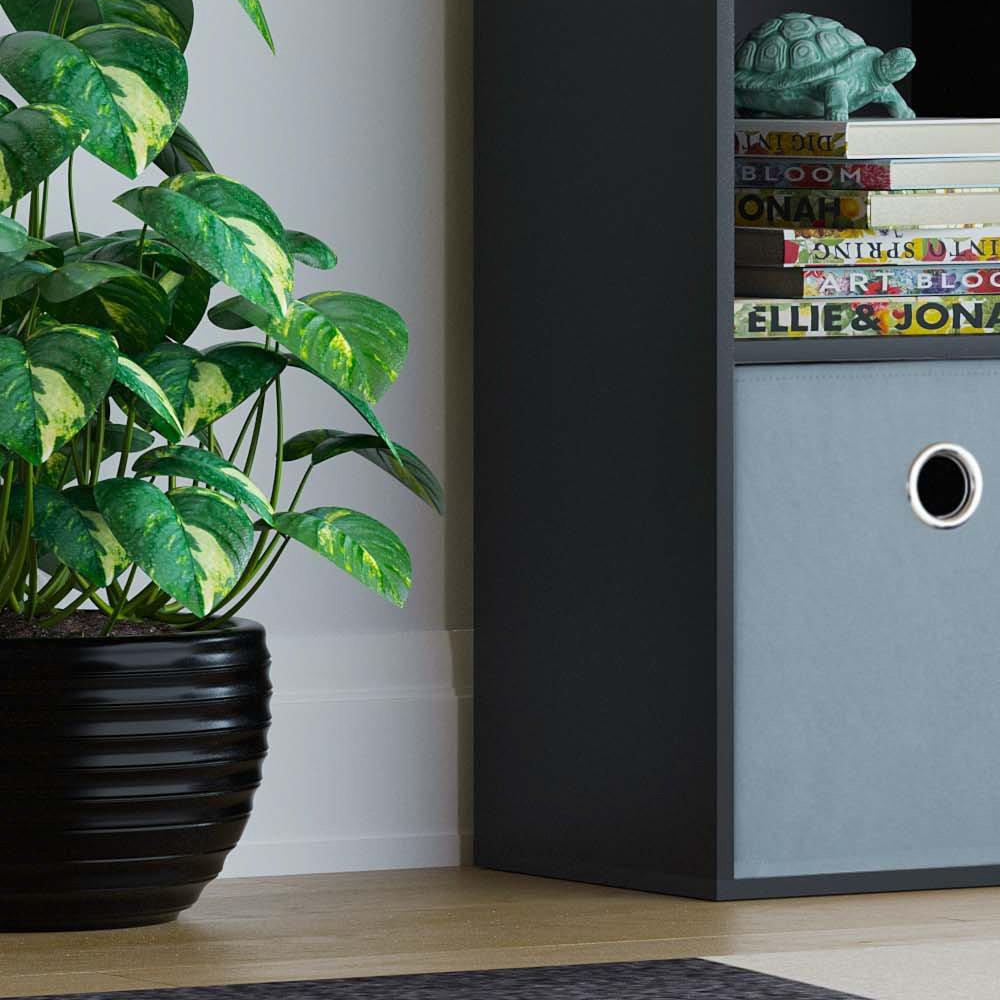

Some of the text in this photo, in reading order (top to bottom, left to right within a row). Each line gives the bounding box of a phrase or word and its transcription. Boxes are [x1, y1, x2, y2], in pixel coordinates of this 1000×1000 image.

[735, 134, 832, 150] DIG INT
[742, 166, 862, 184] BLOOM
[814, 241, 915, 259] SPRING
[929, 239, 999, 257] INTO
[819, 272, 895, 293] ART
[748, 307, 842, 333] ELLIE
[850, 304, 883, 331] &
